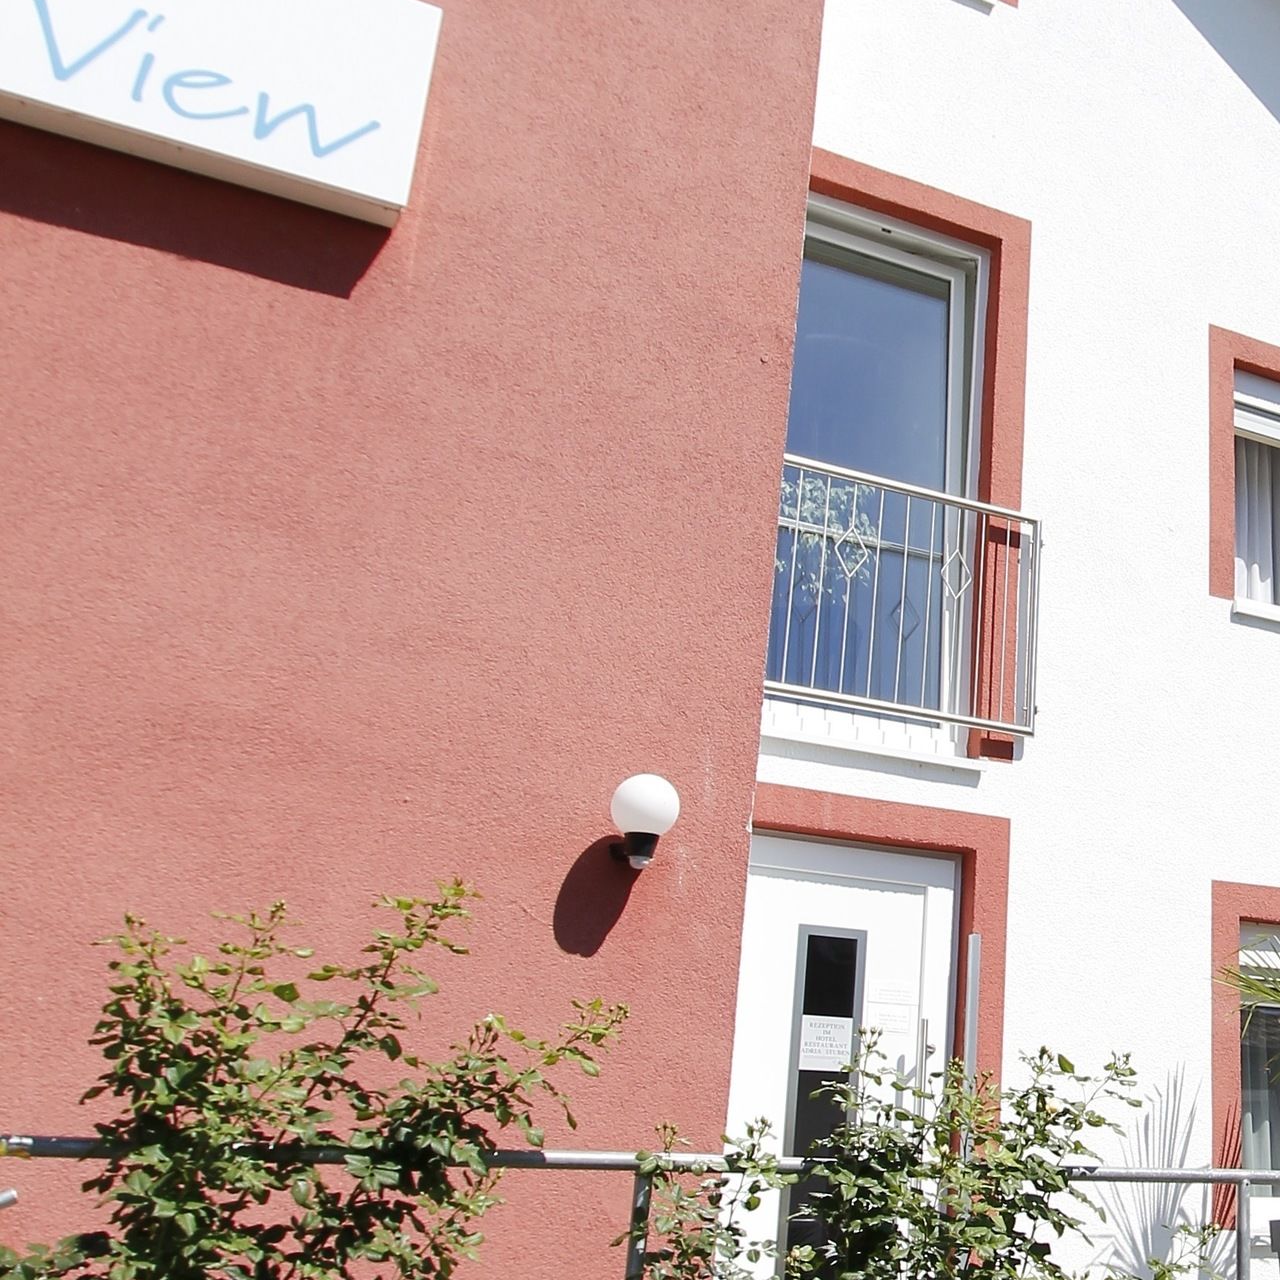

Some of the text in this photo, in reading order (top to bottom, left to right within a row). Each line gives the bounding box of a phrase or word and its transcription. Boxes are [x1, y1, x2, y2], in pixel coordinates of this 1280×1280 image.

[809, 1022, 846, 1030] REZEPTION
[815, 1035, 838, 1043] HOTEL
[804, 1041, 849, 1050] RESTAURANT
